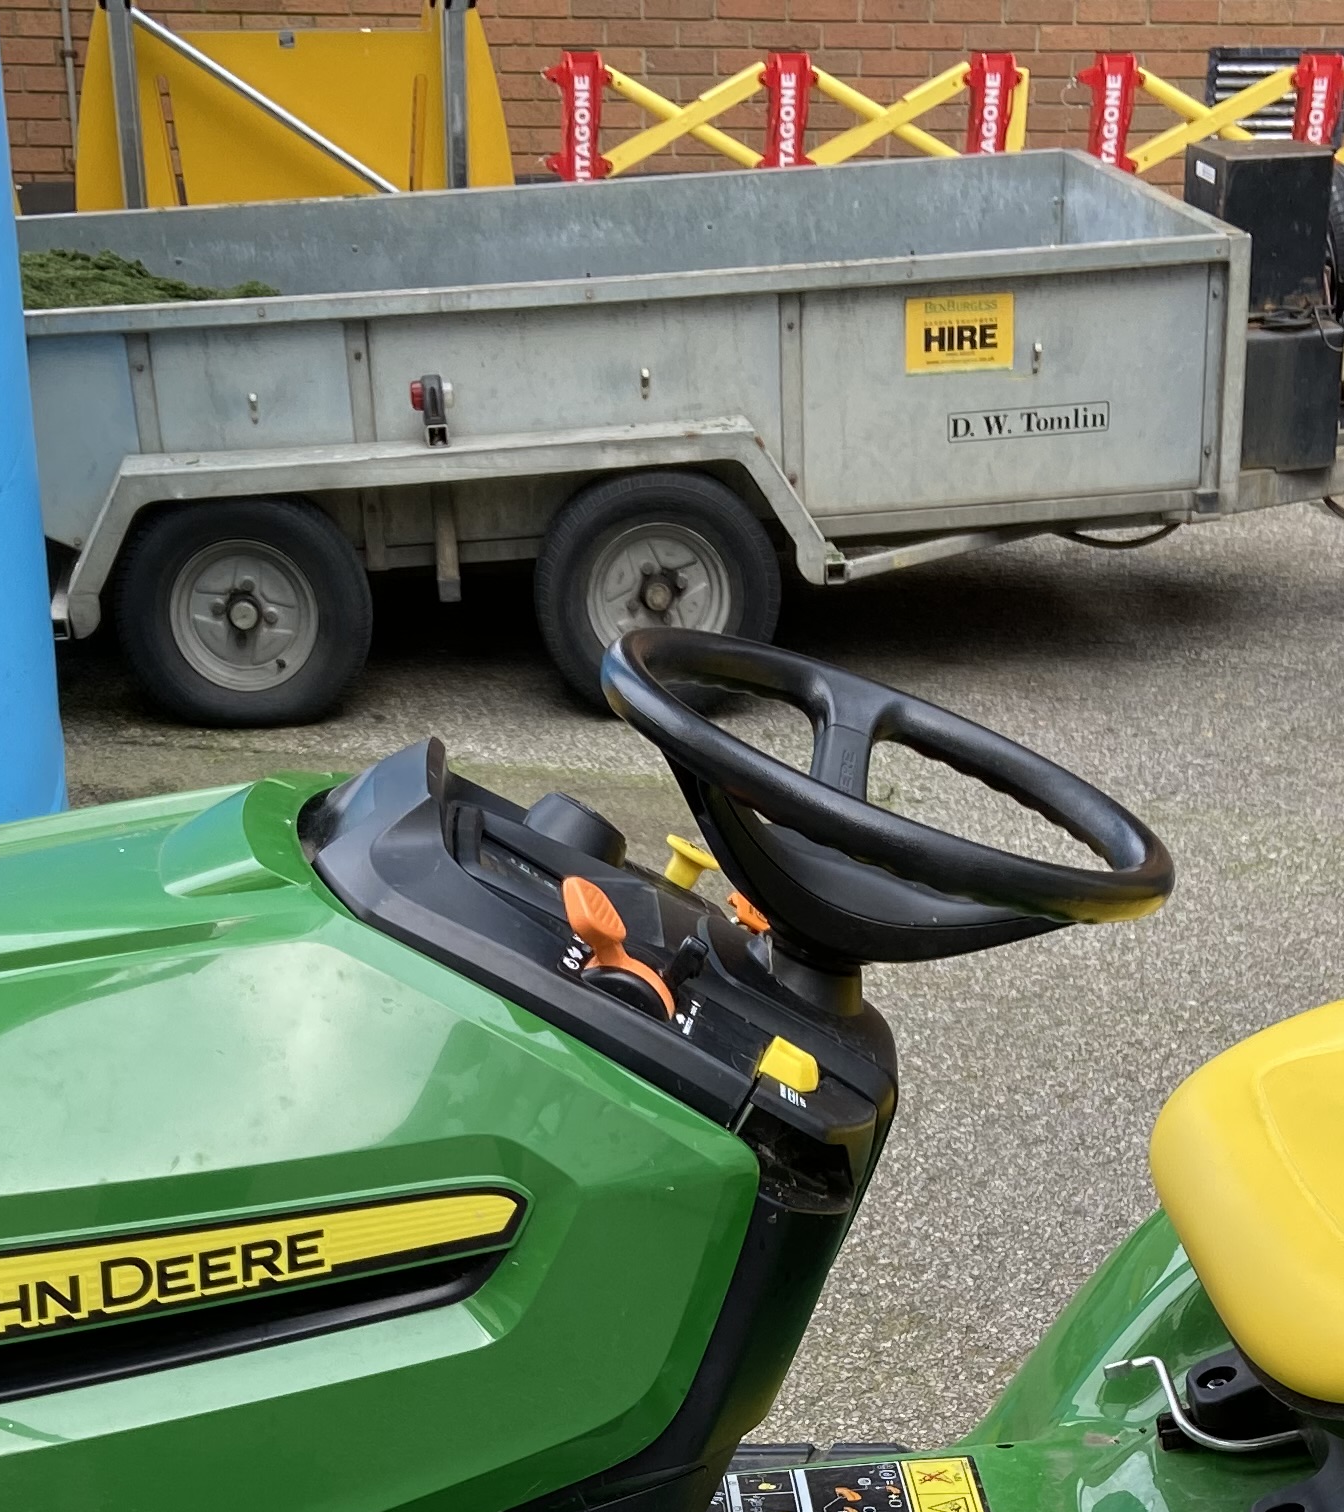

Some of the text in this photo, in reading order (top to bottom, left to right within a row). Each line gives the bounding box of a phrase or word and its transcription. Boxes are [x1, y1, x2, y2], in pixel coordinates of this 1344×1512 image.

[574, 75, 591, 183] ITAGONE
[779, 73, 796, 168] TAGONE
[980, 72, 1002, 154] AGONE
[1101, 73, 1122, 163] TAGONE
[1307, 76, 1329, 145] GONE
[924, 324, 998, 352] HIRE
[952, 407, 1106, 438] D. W. Tomlin
[99, 1228, 326, 1308] DEERE
